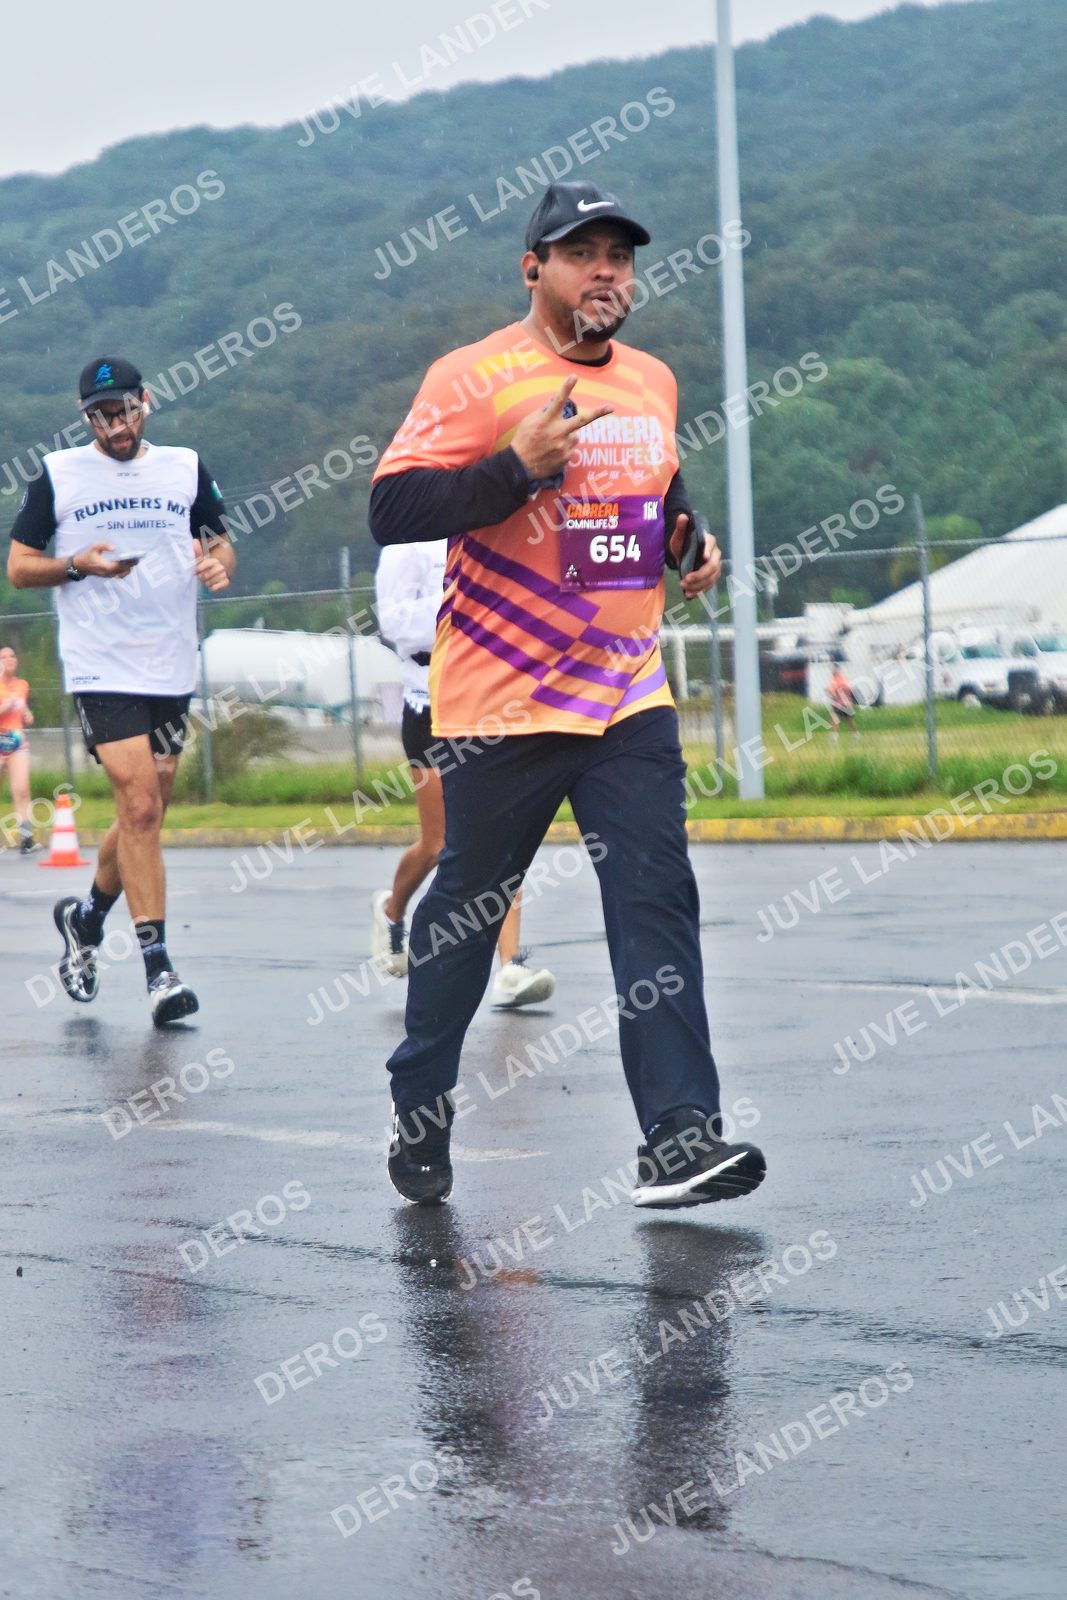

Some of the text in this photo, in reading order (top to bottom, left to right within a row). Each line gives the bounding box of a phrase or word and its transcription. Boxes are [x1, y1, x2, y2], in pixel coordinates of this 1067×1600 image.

[576, 415, 664, 444] ARRERA
[74, 497, 187, 522] RUNNERS MX
[567, 503, 619, 518] CARRERA
[107, 520, 124, 530] SIN
[567, 519, 608, 530] OMNILIFE
[589, 534, 641, 563] 654
